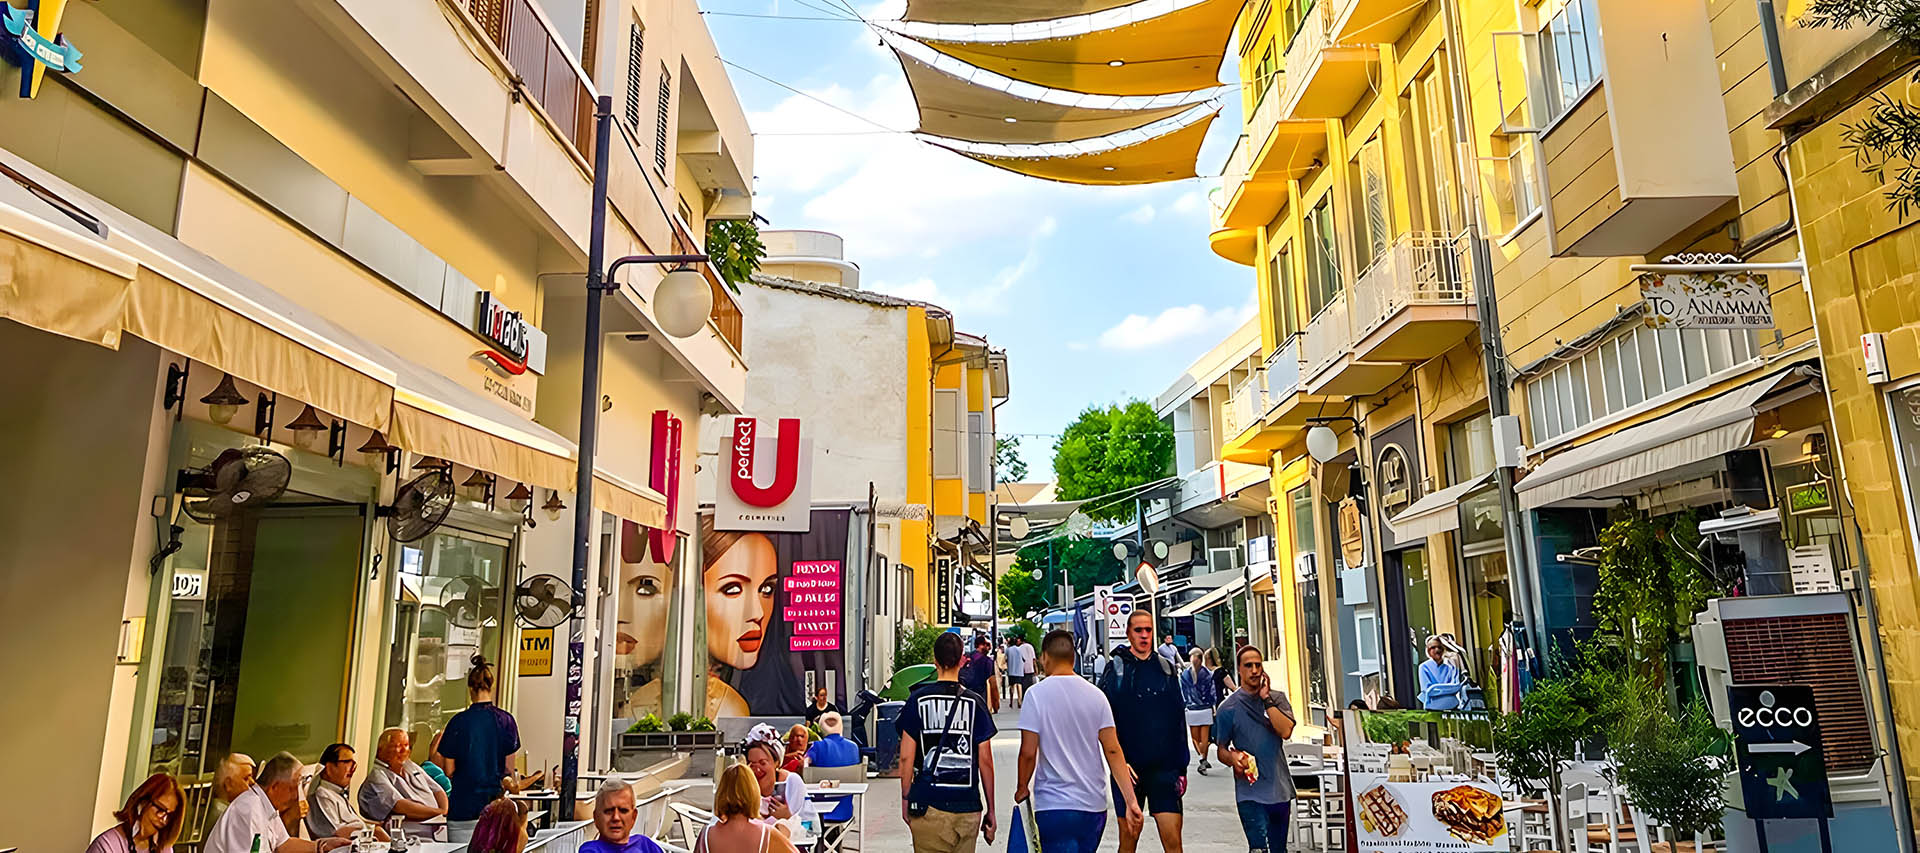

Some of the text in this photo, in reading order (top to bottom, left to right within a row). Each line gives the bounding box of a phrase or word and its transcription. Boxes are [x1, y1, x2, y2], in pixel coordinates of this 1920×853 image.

[1647, 297, 1769, 316] TO ANAMMA
[735, 421, 752, 480] perfect
[1738, 707, 1813, 728] ecco
